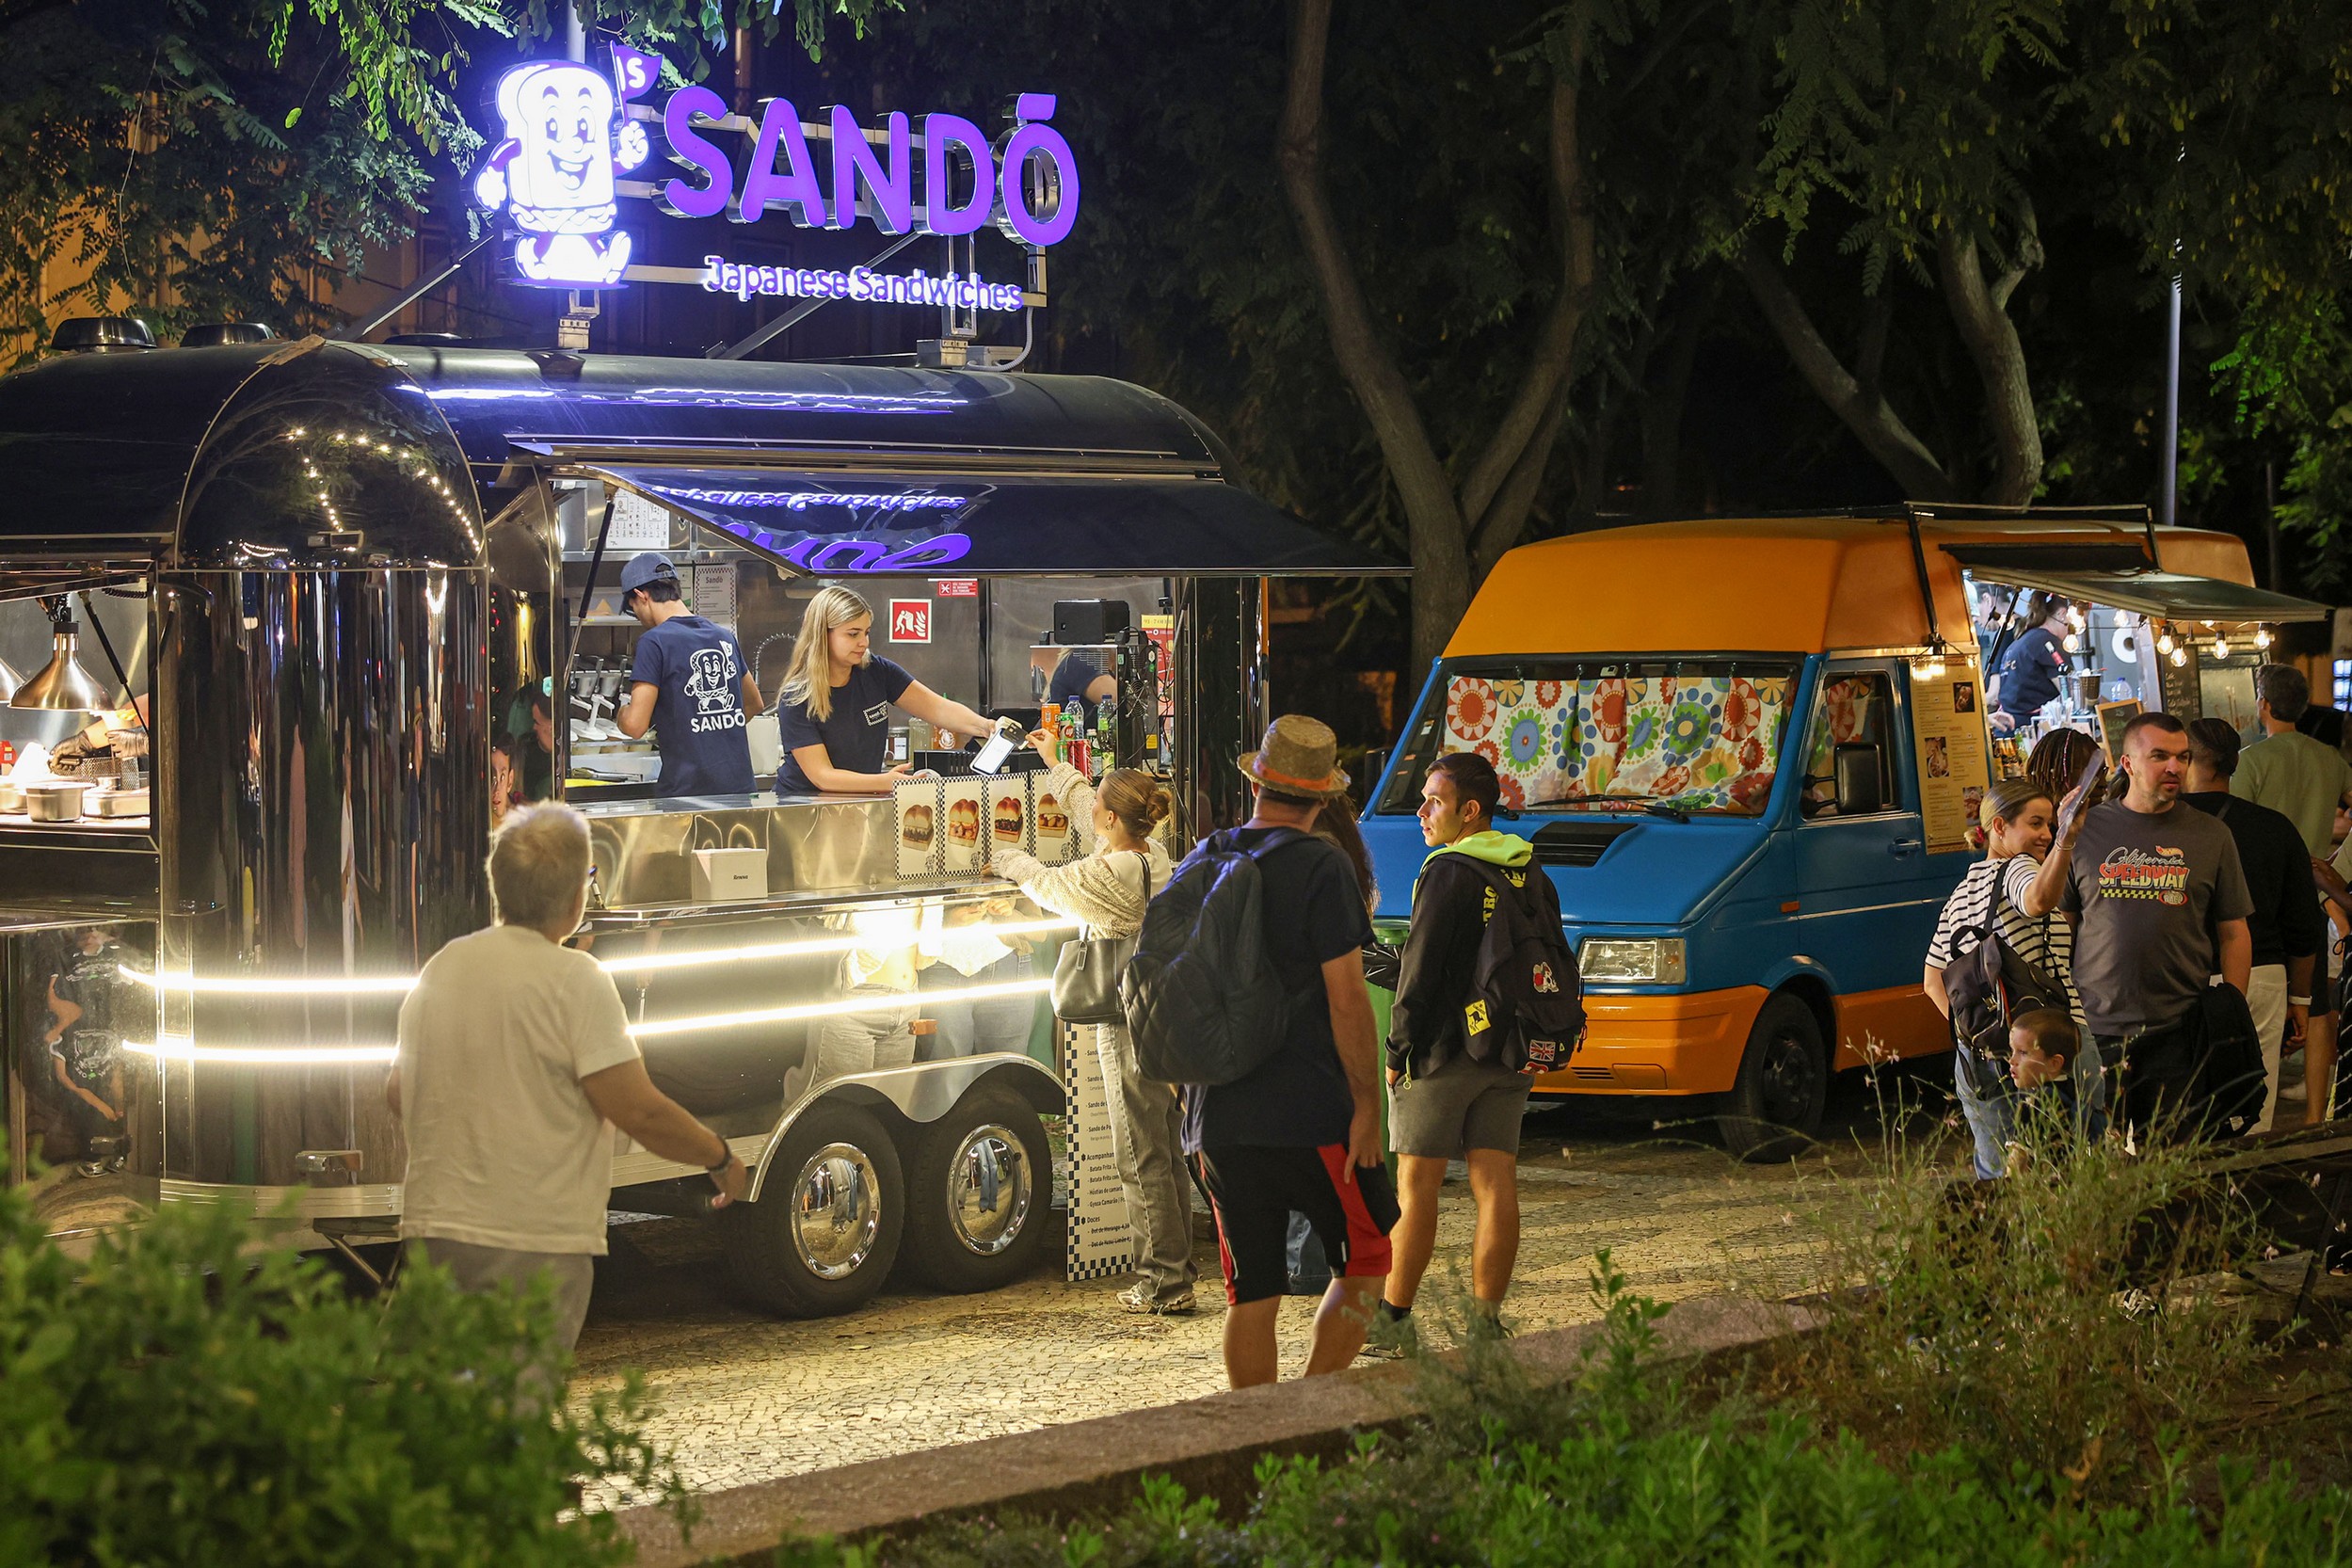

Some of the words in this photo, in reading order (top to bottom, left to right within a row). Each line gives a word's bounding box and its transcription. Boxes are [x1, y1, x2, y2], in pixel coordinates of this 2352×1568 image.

[627, 57, 646, 88] S
[664, 86, 1080, 247] SANDŌ
[704, 255, 850, 302] Japanese
[850, 265, 1024, 312] Sandwiches
[690, 709, 745, 733] SANDŌ
[2104, 846, 2185, 867] California
[2098, 863, 2190, 890] SPEEDWAY
